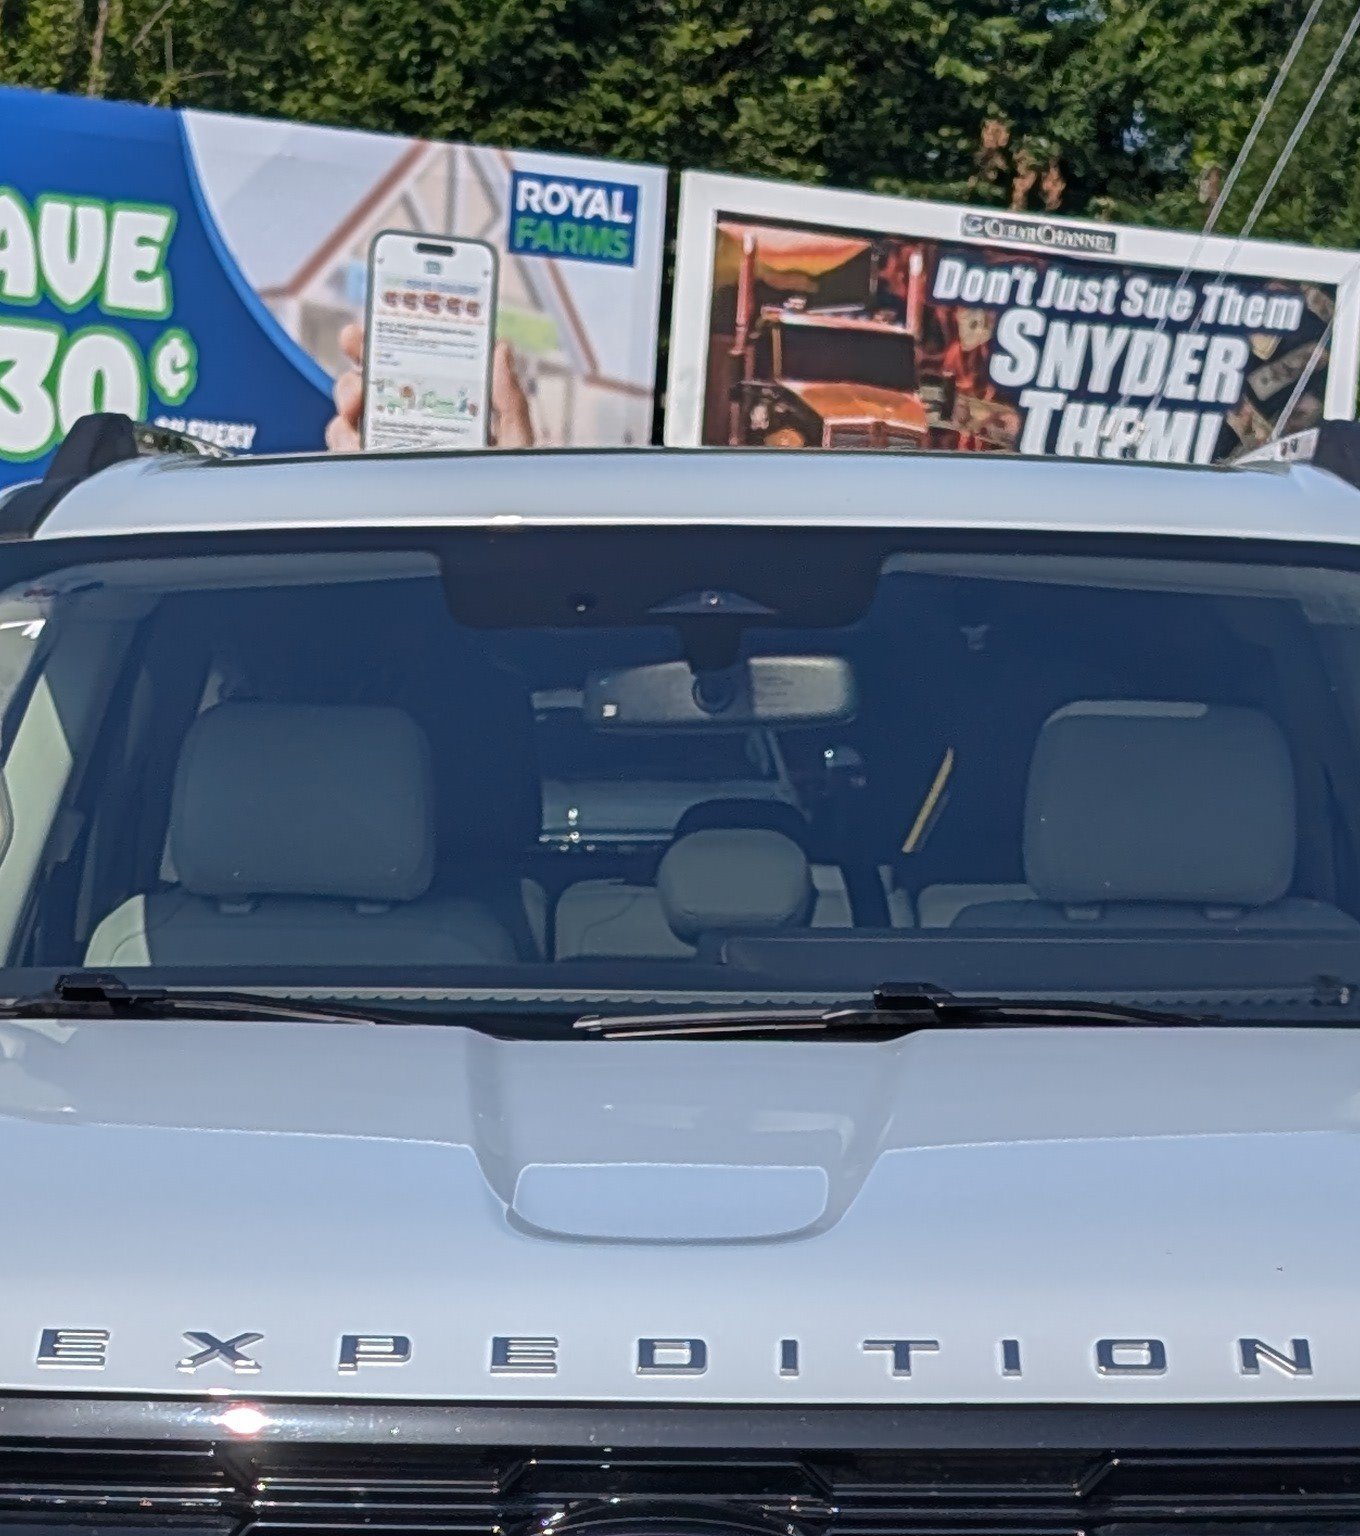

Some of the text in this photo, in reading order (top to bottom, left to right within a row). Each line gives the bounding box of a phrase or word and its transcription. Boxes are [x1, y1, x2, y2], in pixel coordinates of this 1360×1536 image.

[516, 179, 633, 224] ROYAL
[514, 216, 630, 259] FARMS
[932, 256, 1305, 332] Don't Just Sue Them
[989, 307, 1250, 405] SNYDER
[36, 1326, 1315, 1380] EXPEDITION
